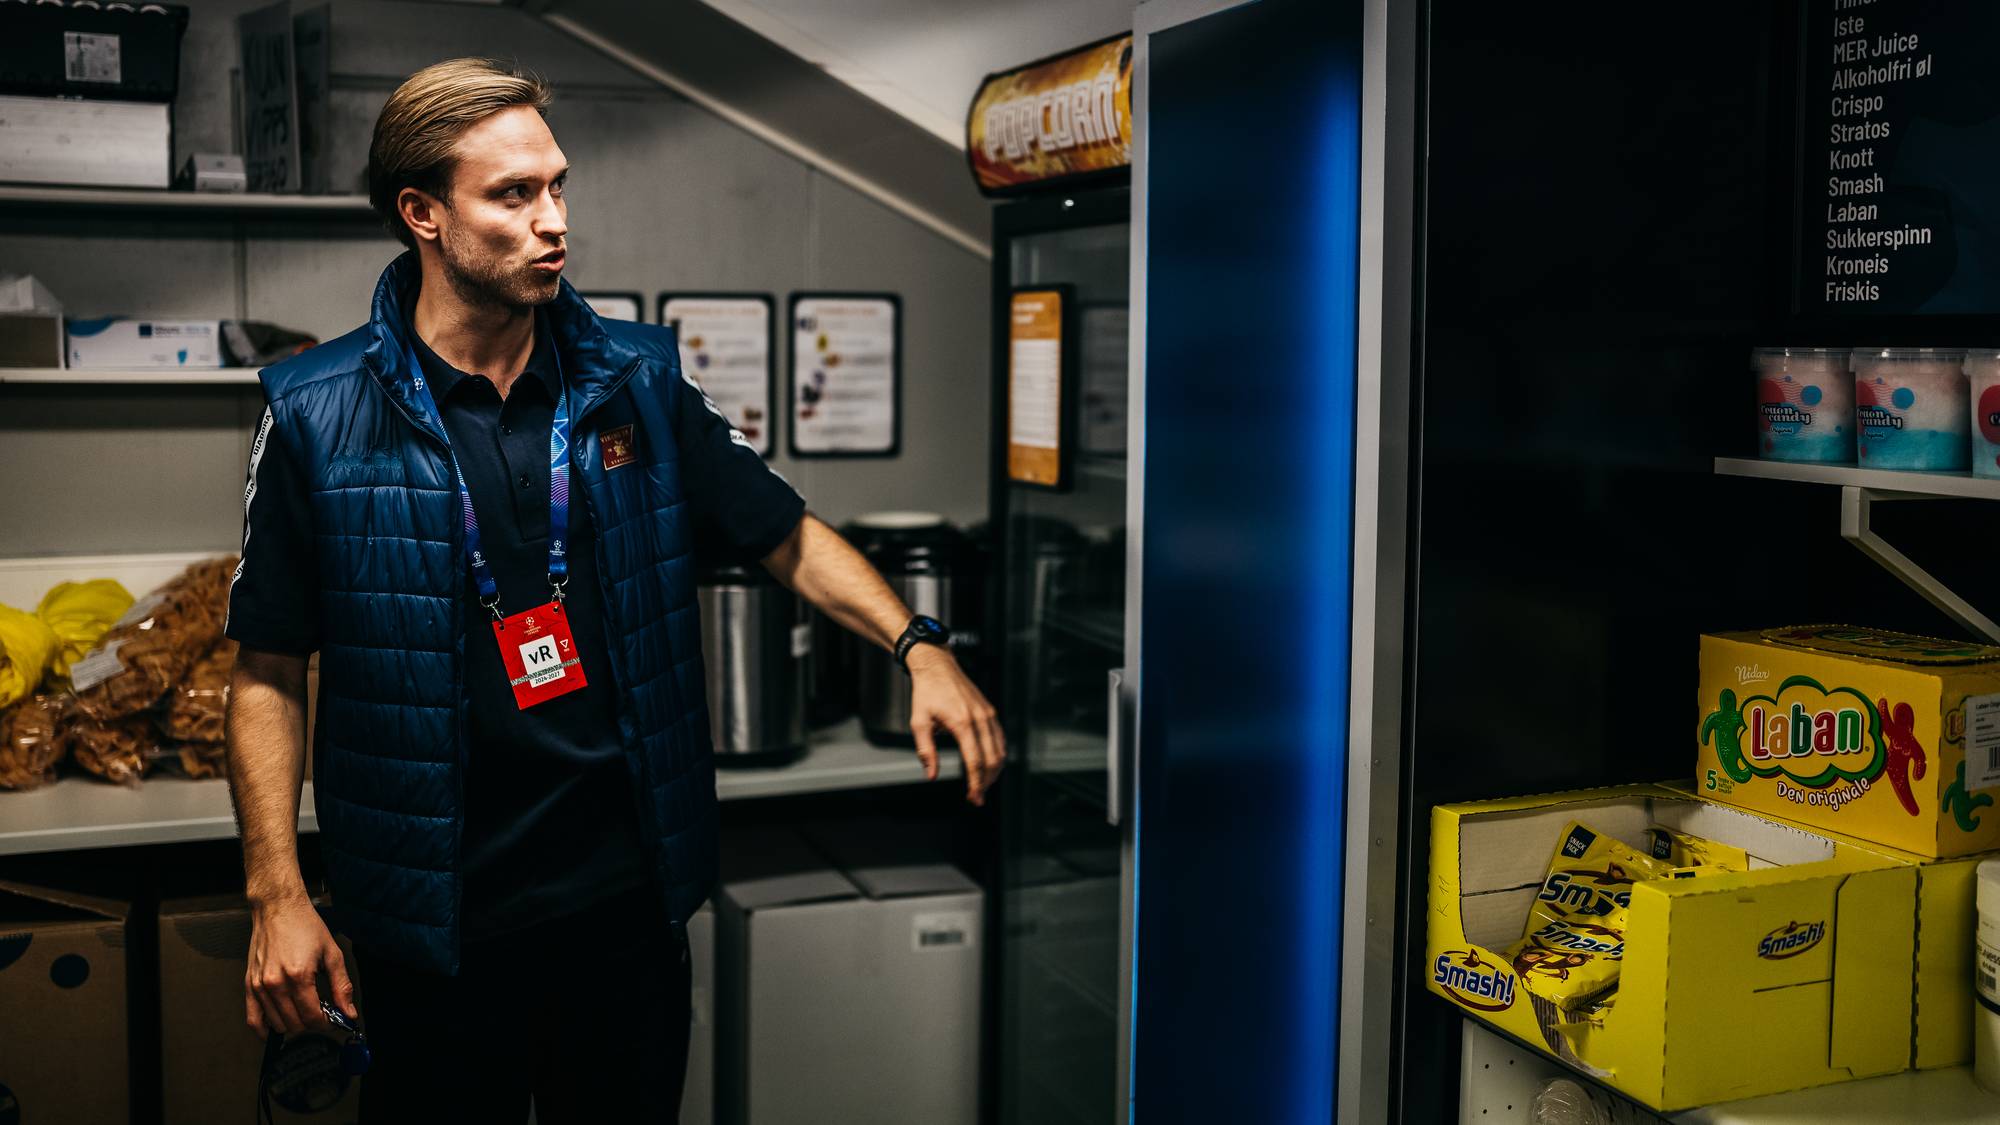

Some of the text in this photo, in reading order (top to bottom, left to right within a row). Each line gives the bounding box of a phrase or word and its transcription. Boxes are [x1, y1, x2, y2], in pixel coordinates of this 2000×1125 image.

[1834, 16, 1864, 37] Iste
[1833, 33, 1918, 64] MER Juice
[1832, 54, 1932, 91] Alkoholfri øl
[984, 73, 1118, 162] POPCORN
[1832, 95, 1883, 118] Crispo
[1831, 121, 1890, 143] Stratos
[1830, 148, 1874, 170] Knott
[1829, 173, 1884, 196] Smash
[1828, 202, 1877, 223] Laban
[1827, 224, 1931, 250] Sukkerspinn
[1827, 253, 1889, 275] Kroneis
[1826, 281, 1880, 301] Friskis
[1769, 411, 1811, 425] candy
[253, 415, 271, 455] DIADORA
[528, 645, 554, 664] vR
[1735, 664, 1770, 682] Nidar
[1751, 702, 1862, 760] Laban
[1706, 769, 1718, 791] 5
[1565, 842, 1579, 855] PACK
[1568, 836, 1587, 851] SNACK
[1758, 920, 1825, 957] Smash!
[1434, 954, 1515, 1005] Smash!
